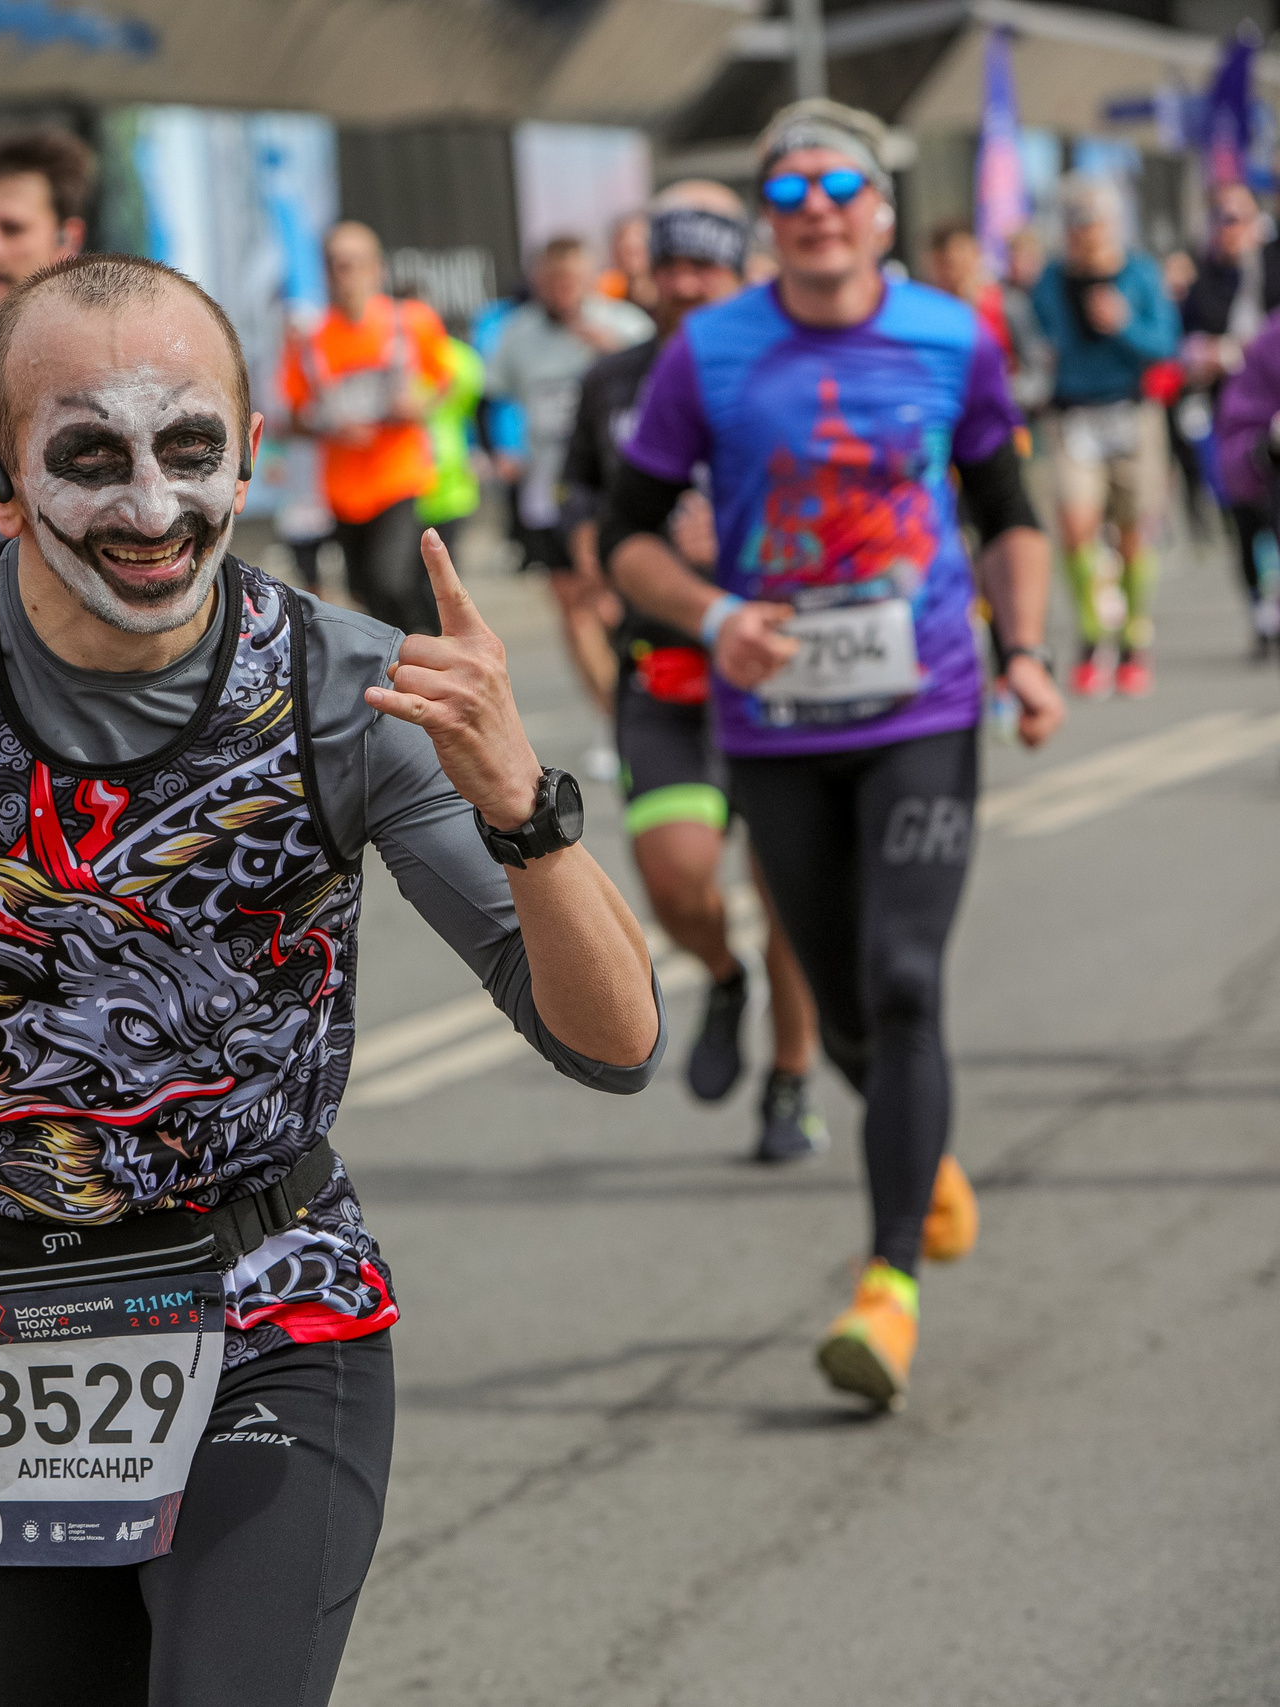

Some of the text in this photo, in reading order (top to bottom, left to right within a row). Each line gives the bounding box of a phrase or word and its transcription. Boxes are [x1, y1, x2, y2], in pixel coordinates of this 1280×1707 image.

[14, 1297, 114, 1320] МОСКОВСКИЙ
[124, 1296, 158, 1313] 21,1
[17, 1317, 57, 1330] ПОЛУ
[20, 1324, 92, 1339] МАРАФОН
[211, 1432, 298, 1447] DEMIX
[17, 1457, 154, 1483] АЛЕКСАНДР
